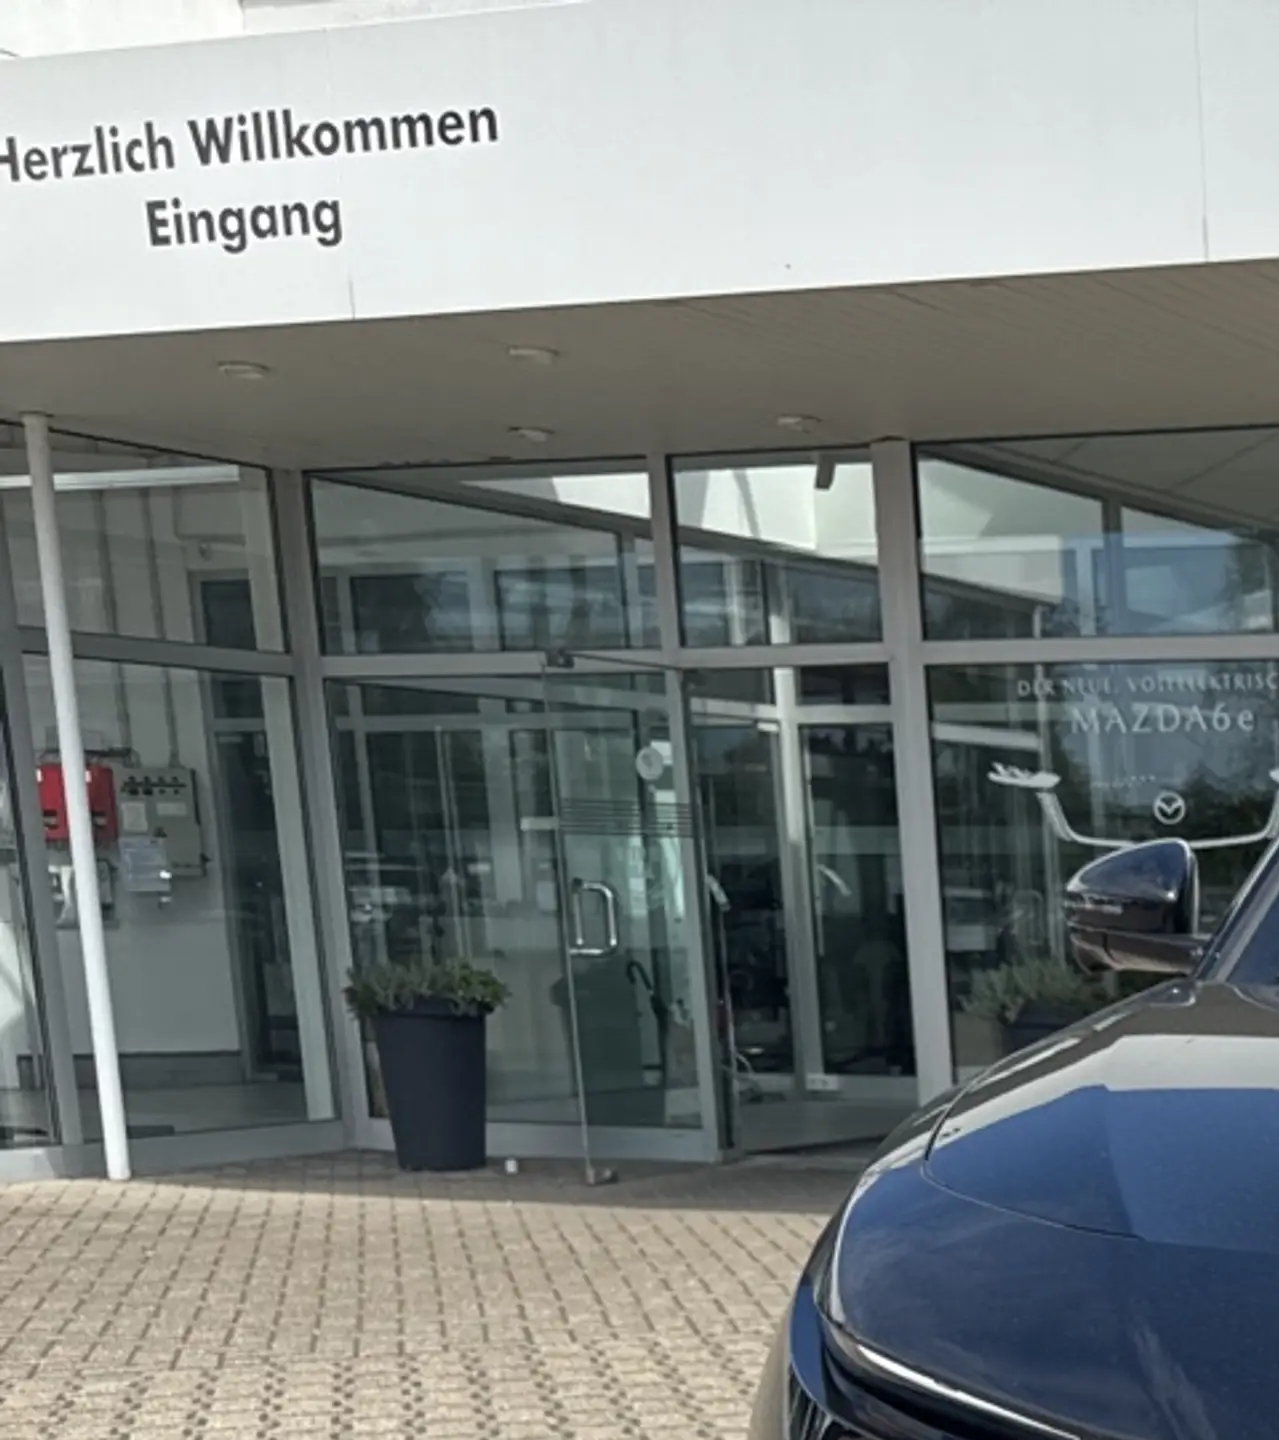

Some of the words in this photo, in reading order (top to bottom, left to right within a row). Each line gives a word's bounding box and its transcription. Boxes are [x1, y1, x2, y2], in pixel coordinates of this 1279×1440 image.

[0, 121, 175, 182] Herzlich
[187, 106, 498, 166] Willkommen
[146, 197, 342, 254] Eingang
[1070, 702, 1255, 734] MAZDA6e
